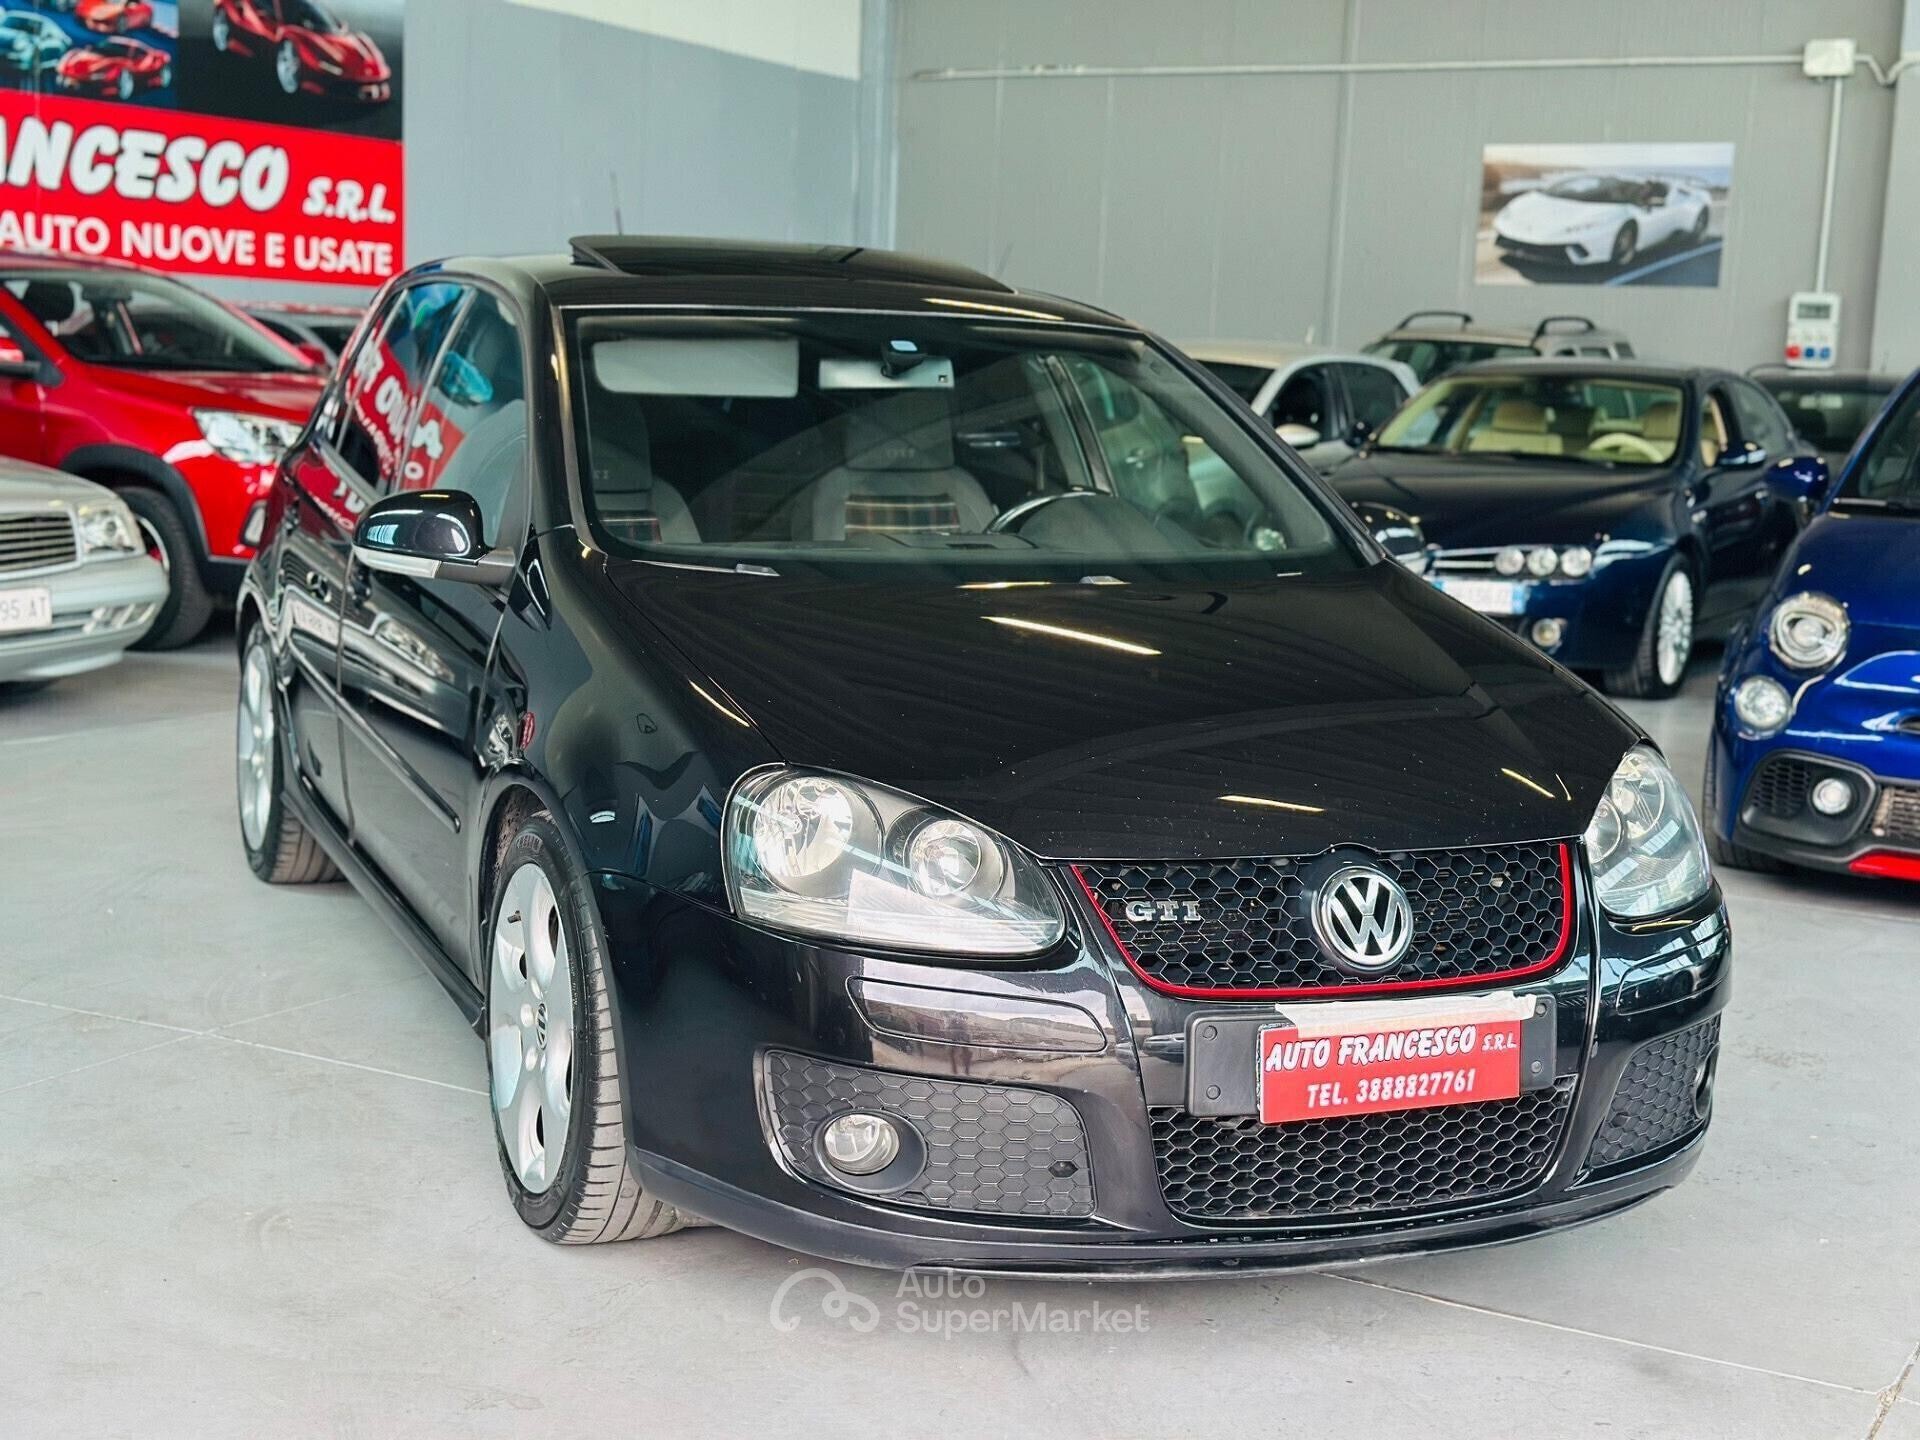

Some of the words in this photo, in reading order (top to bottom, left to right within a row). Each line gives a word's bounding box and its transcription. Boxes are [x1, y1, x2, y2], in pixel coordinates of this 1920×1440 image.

[0, 115, 289, 212] NCESCO
[0, 209, 111, 256] AUTO
[121, 220, 256, 266] NUOVE
[265, 233, 285, 267] E
[294, 236, 393, 276] USATE
[1125, 900, 1200, 921] GTI
[1265, 1039, 1331, 1072] AUTO
[1337, 1024, 1477, 1066] FRANCESCO
[1307, 1082, 1348, 1109] TEL.
[1356, 1069, 1476, 1104] 3888827761
